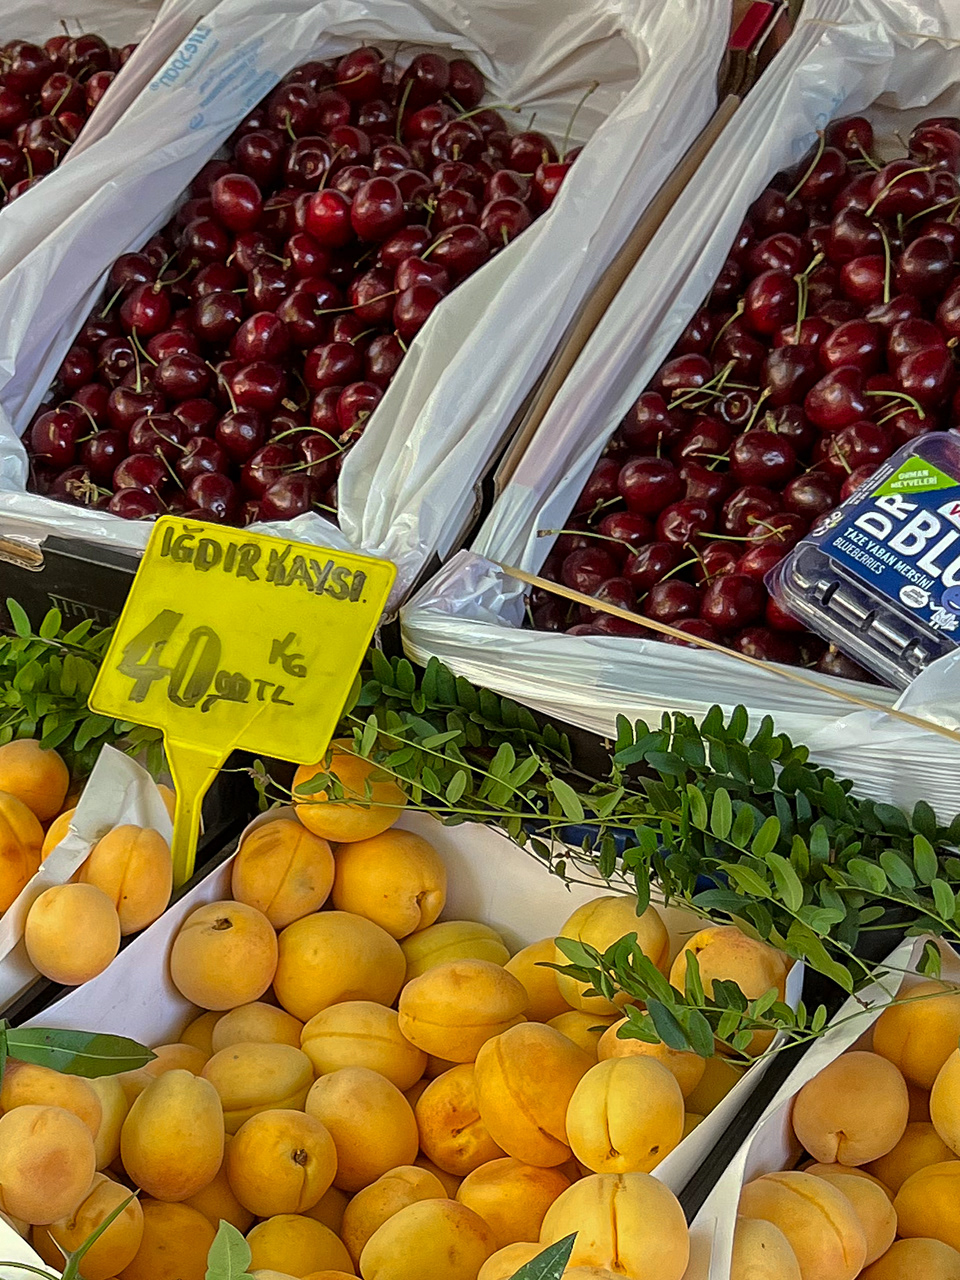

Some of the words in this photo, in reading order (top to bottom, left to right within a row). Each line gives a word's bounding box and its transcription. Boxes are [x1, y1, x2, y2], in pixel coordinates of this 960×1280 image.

[854, 493, 919, 541] DR
[832, 536, 886, 575] BLUEBERRIES
[844, 527, 869, 547] TAZE
[865, 540, 898, 566] YABAN
[893, 560, 935, 590] MERSİNİ
